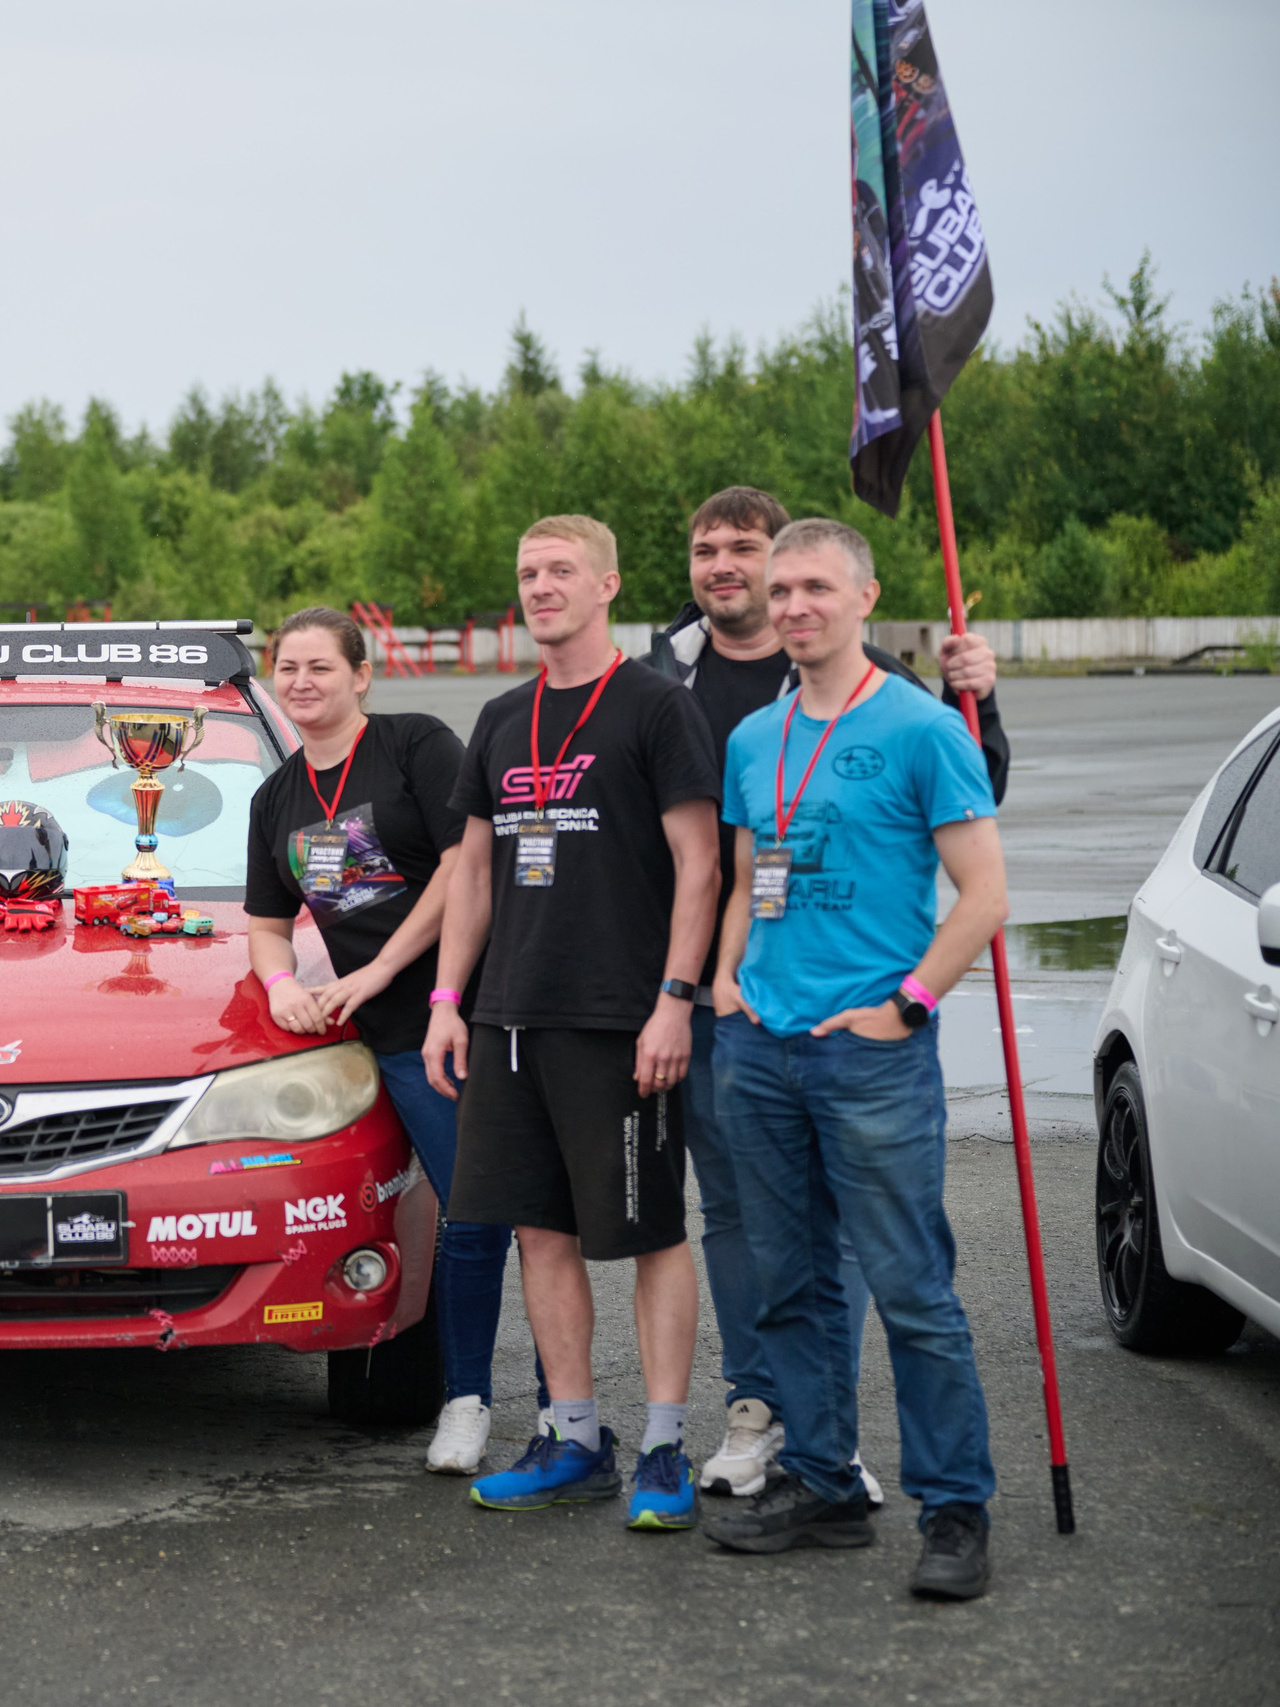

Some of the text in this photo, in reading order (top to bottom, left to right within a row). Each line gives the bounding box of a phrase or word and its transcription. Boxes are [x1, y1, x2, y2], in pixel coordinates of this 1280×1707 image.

[22, 644, 142, 663] CLUB
[149, 645, 208, 663] 86
[284, 1193, 346, 1225] NGK
[57, 1222, 116, 1233] SUBARU
[146, 1210, 257, 1242] MOTUL
[285, 1218, 347, 1235] SPARK PLUGS
[59, 1232, 114, 1241] CLUB 86
[267, 1304, 320, 1320] PIRELLI
